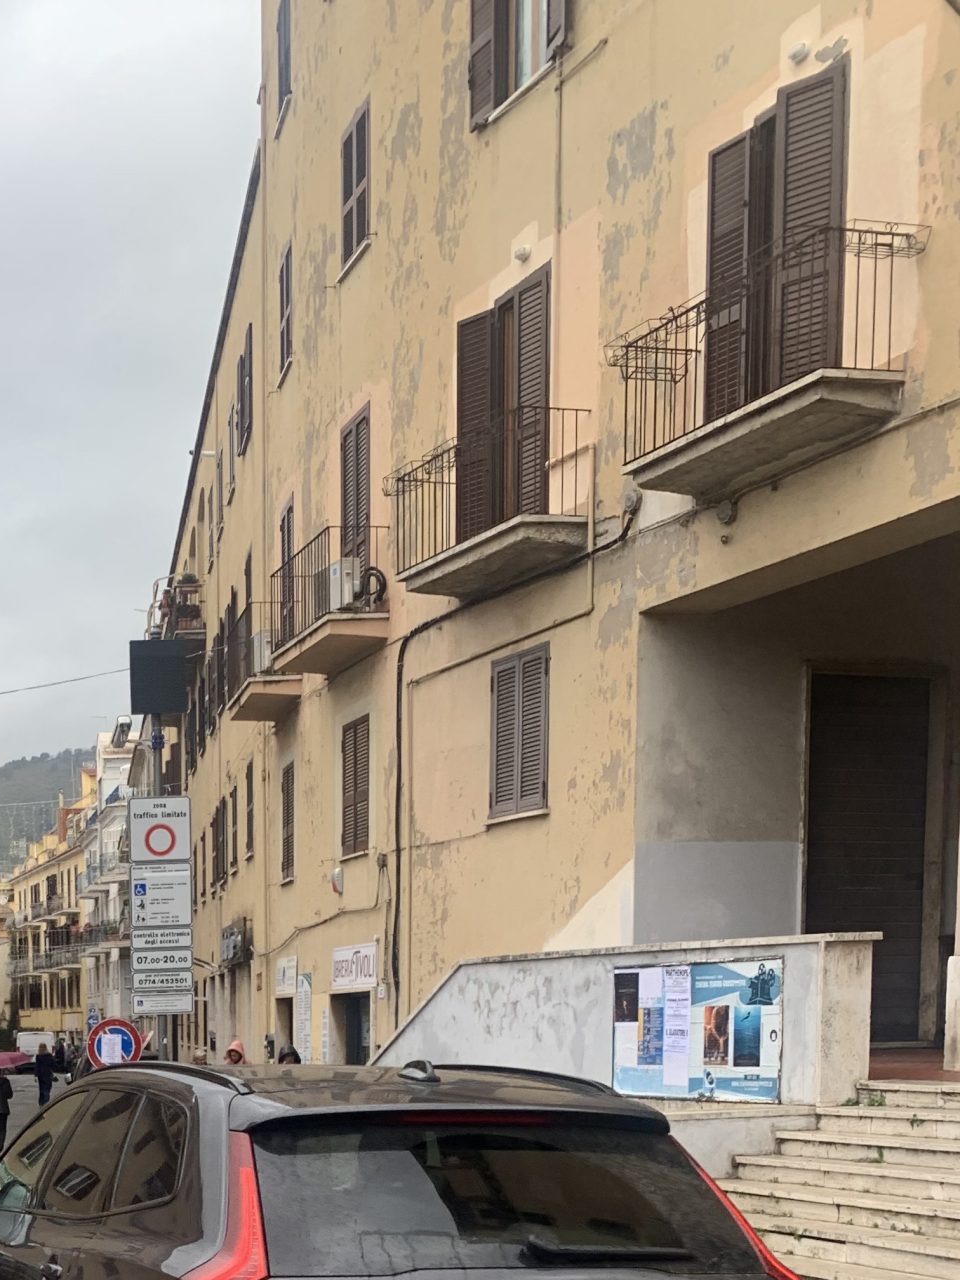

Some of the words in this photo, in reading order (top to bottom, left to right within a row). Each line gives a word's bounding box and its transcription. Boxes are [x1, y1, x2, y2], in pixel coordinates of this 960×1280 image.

[133, 811, 158, 819] traffico
[161, 810, 187, 818] limitato
[133, 931, 159, 939] controllo
[160, 929, 190, 938] elettronico
